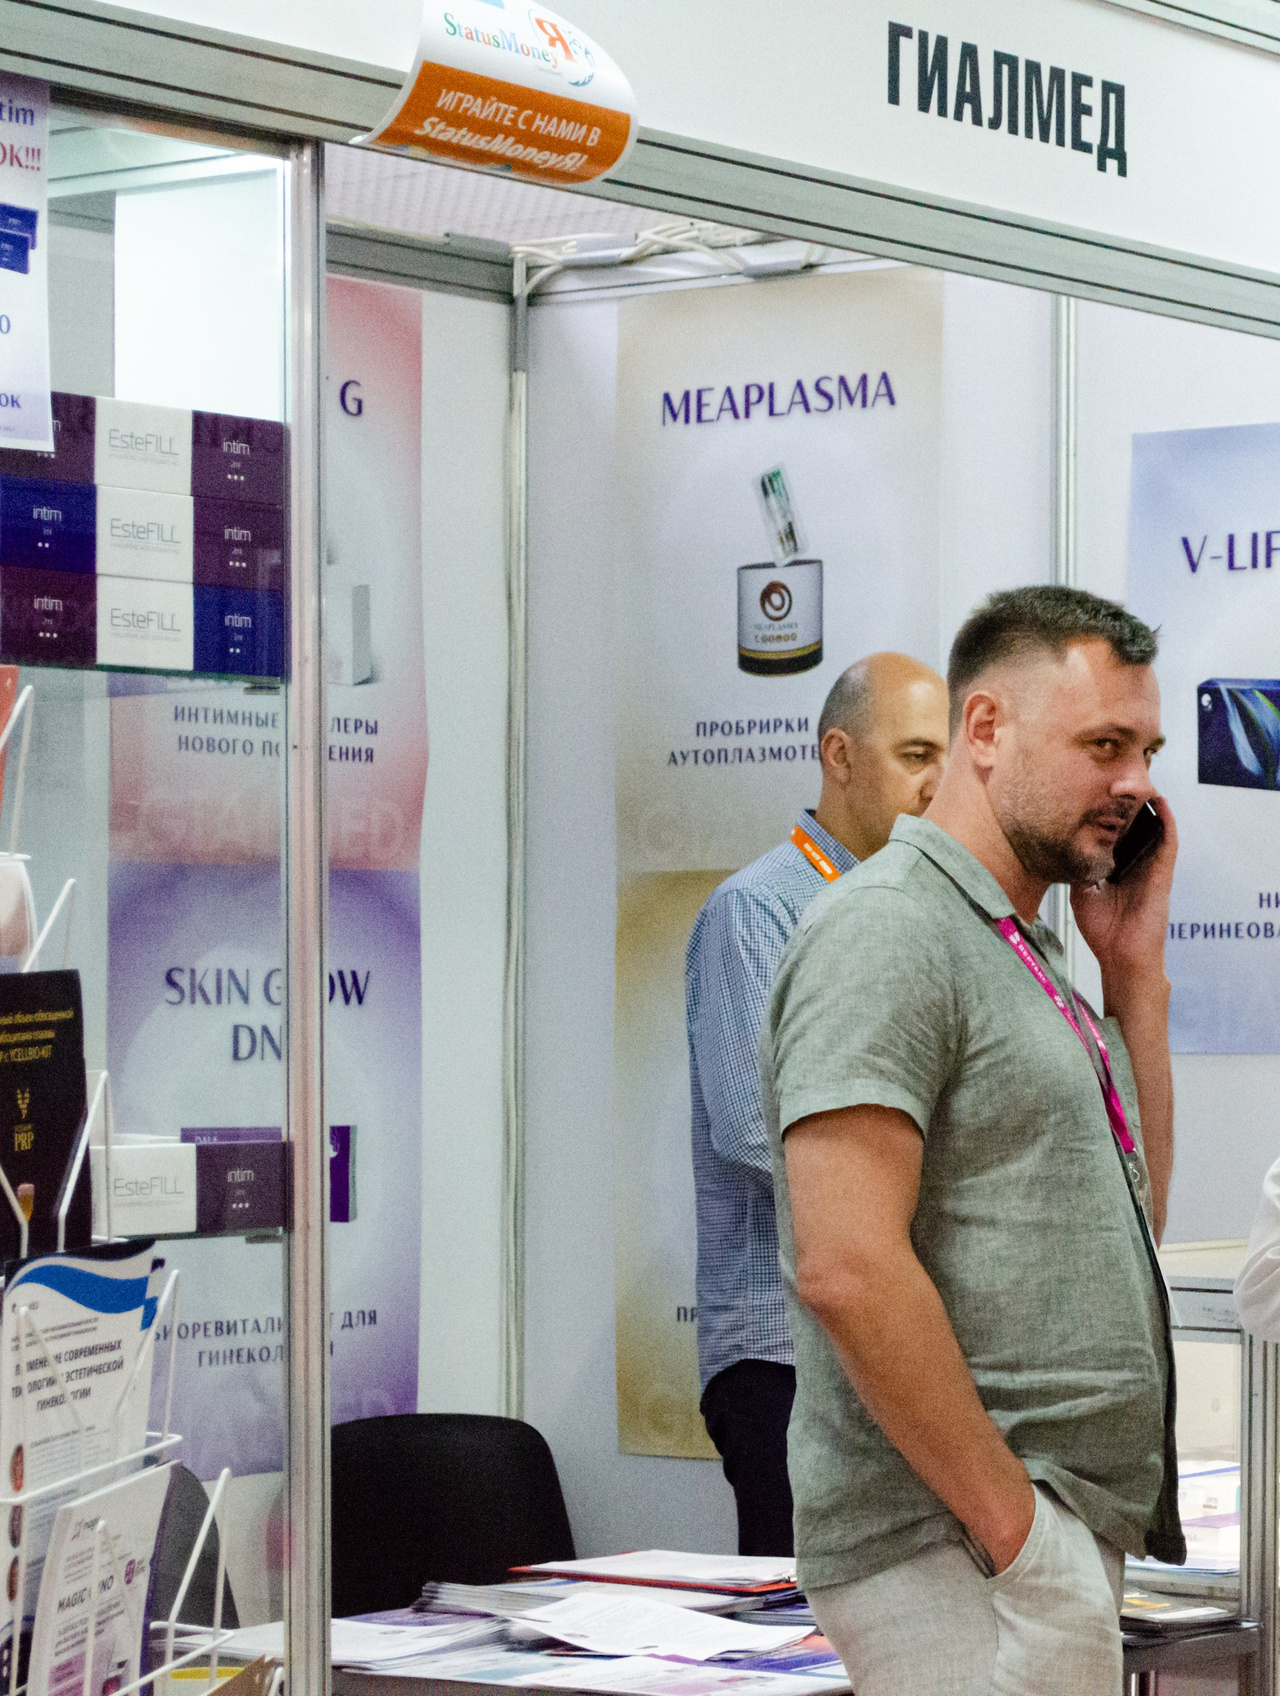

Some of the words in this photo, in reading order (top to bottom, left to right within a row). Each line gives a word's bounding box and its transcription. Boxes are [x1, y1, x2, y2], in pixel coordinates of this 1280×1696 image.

[444, 12, 559, 69] StatusMoney
[887, 20, 1127, 178] ГИАЛМЕД
[436, 88, 516, 127] ИГРАЙТЕ
[518, 109, 533, 128] С
[532, 112, 583, 144] НАМИ
[586, 126, 602, 147] В
[662, 371, 897, 427] MEAPLASMA
[109, 428, 180, 456] EsteFILL
[223, 439, 251, 455] intim
[33, 505, 62, 521] intim
[110, 518, 181, 544] EsteFILL
[224, 525, 251, 542] intim
[34, 595, 63, 612] intim
[110, 607, 181, 632] EsteFILL
[224, 612, 252, 629] intim
[174, 705, 279, 729] ИНТИМНЫЕ
[330, 716, 378, 735] ЛЕРЫ
[696, 716, 809, 738] ПРОБРИРКИ
[178, 735, 255, 757] НОВОГО
[668, 744, 820, 767] АУТОПЛАЗМОТЕ
[165, 966, 249, 1006] SKIN
[232, 1023, 282, 1062] DN
[114, 1176, 185, 1197] EsteFILL
[227, 1168, 254, 1184] intim
[341, 1308, 378, 1330] ДЛЯ
